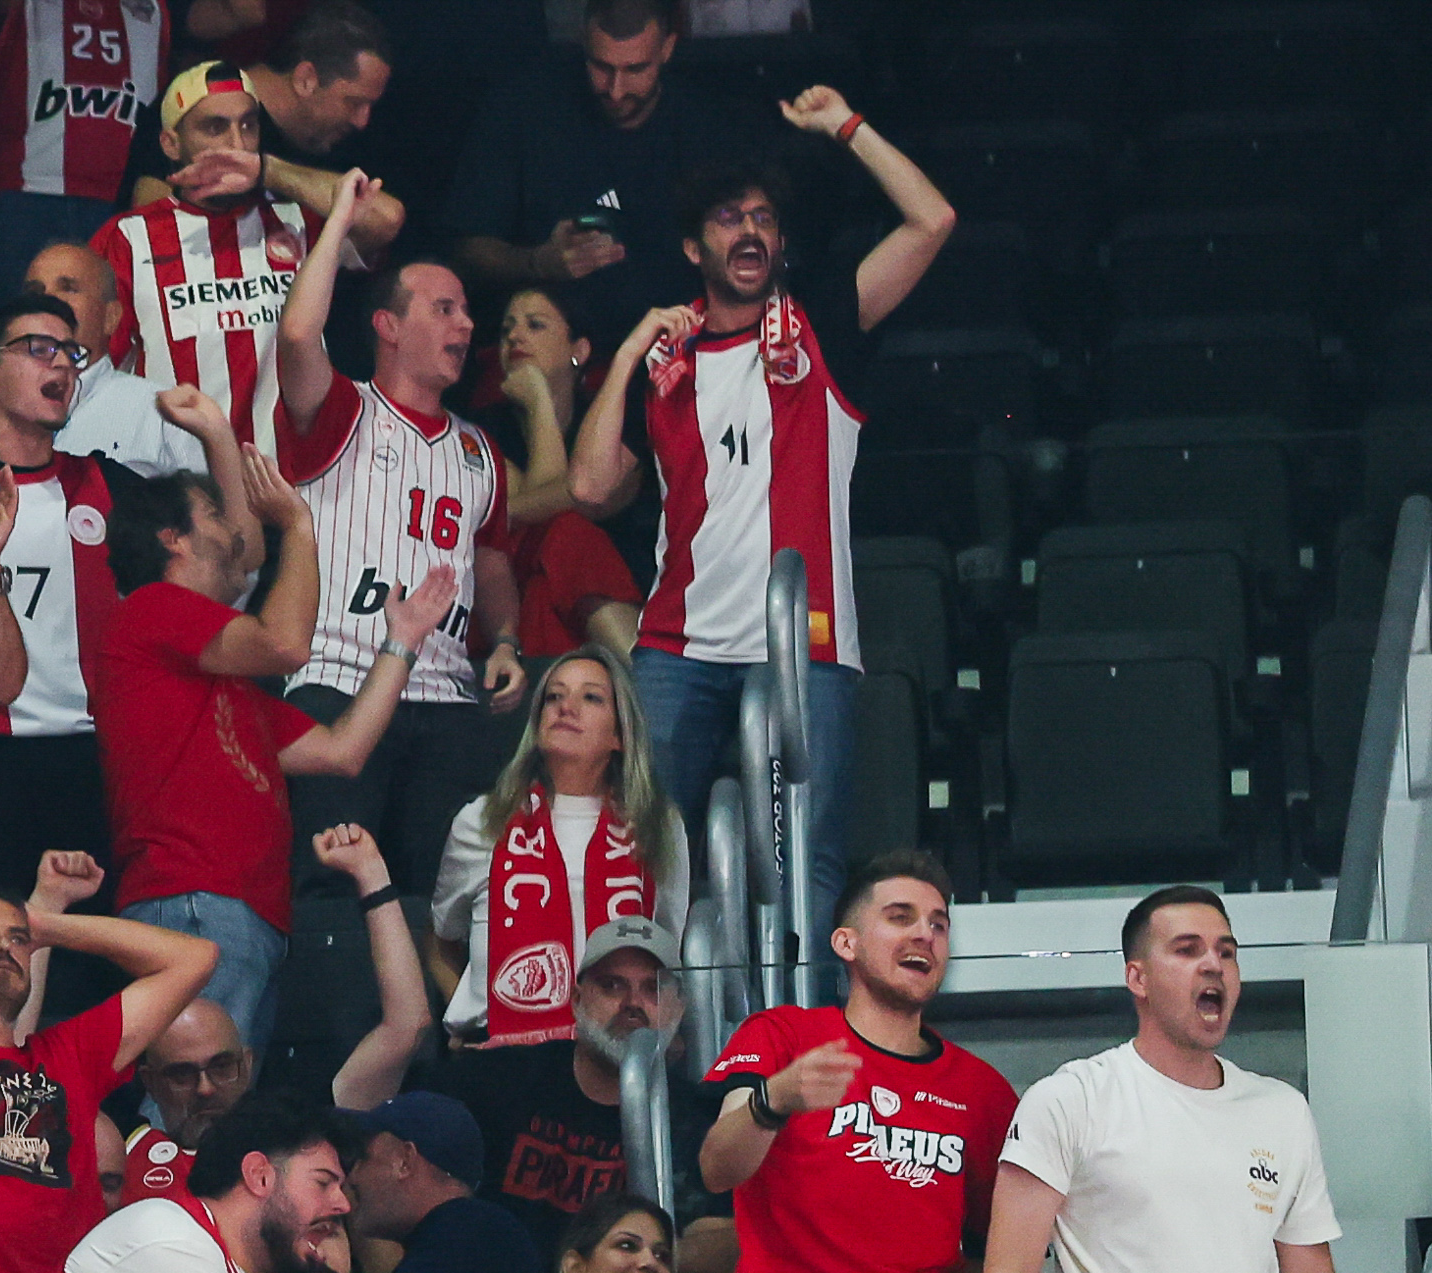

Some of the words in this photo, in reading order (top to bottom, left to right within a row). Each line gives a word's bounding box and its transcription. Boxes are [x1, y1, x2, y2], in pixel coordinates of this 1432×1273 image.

[71, 23, 123, 66] 25
[34, 78, 138, 130] bwi
[168, 274, 294, 311] SIEMENS
[217, 308, 286, 331] mobi
[407, 486, 464, 551] 16
[1249, 1163, 1280, 1186] abc
